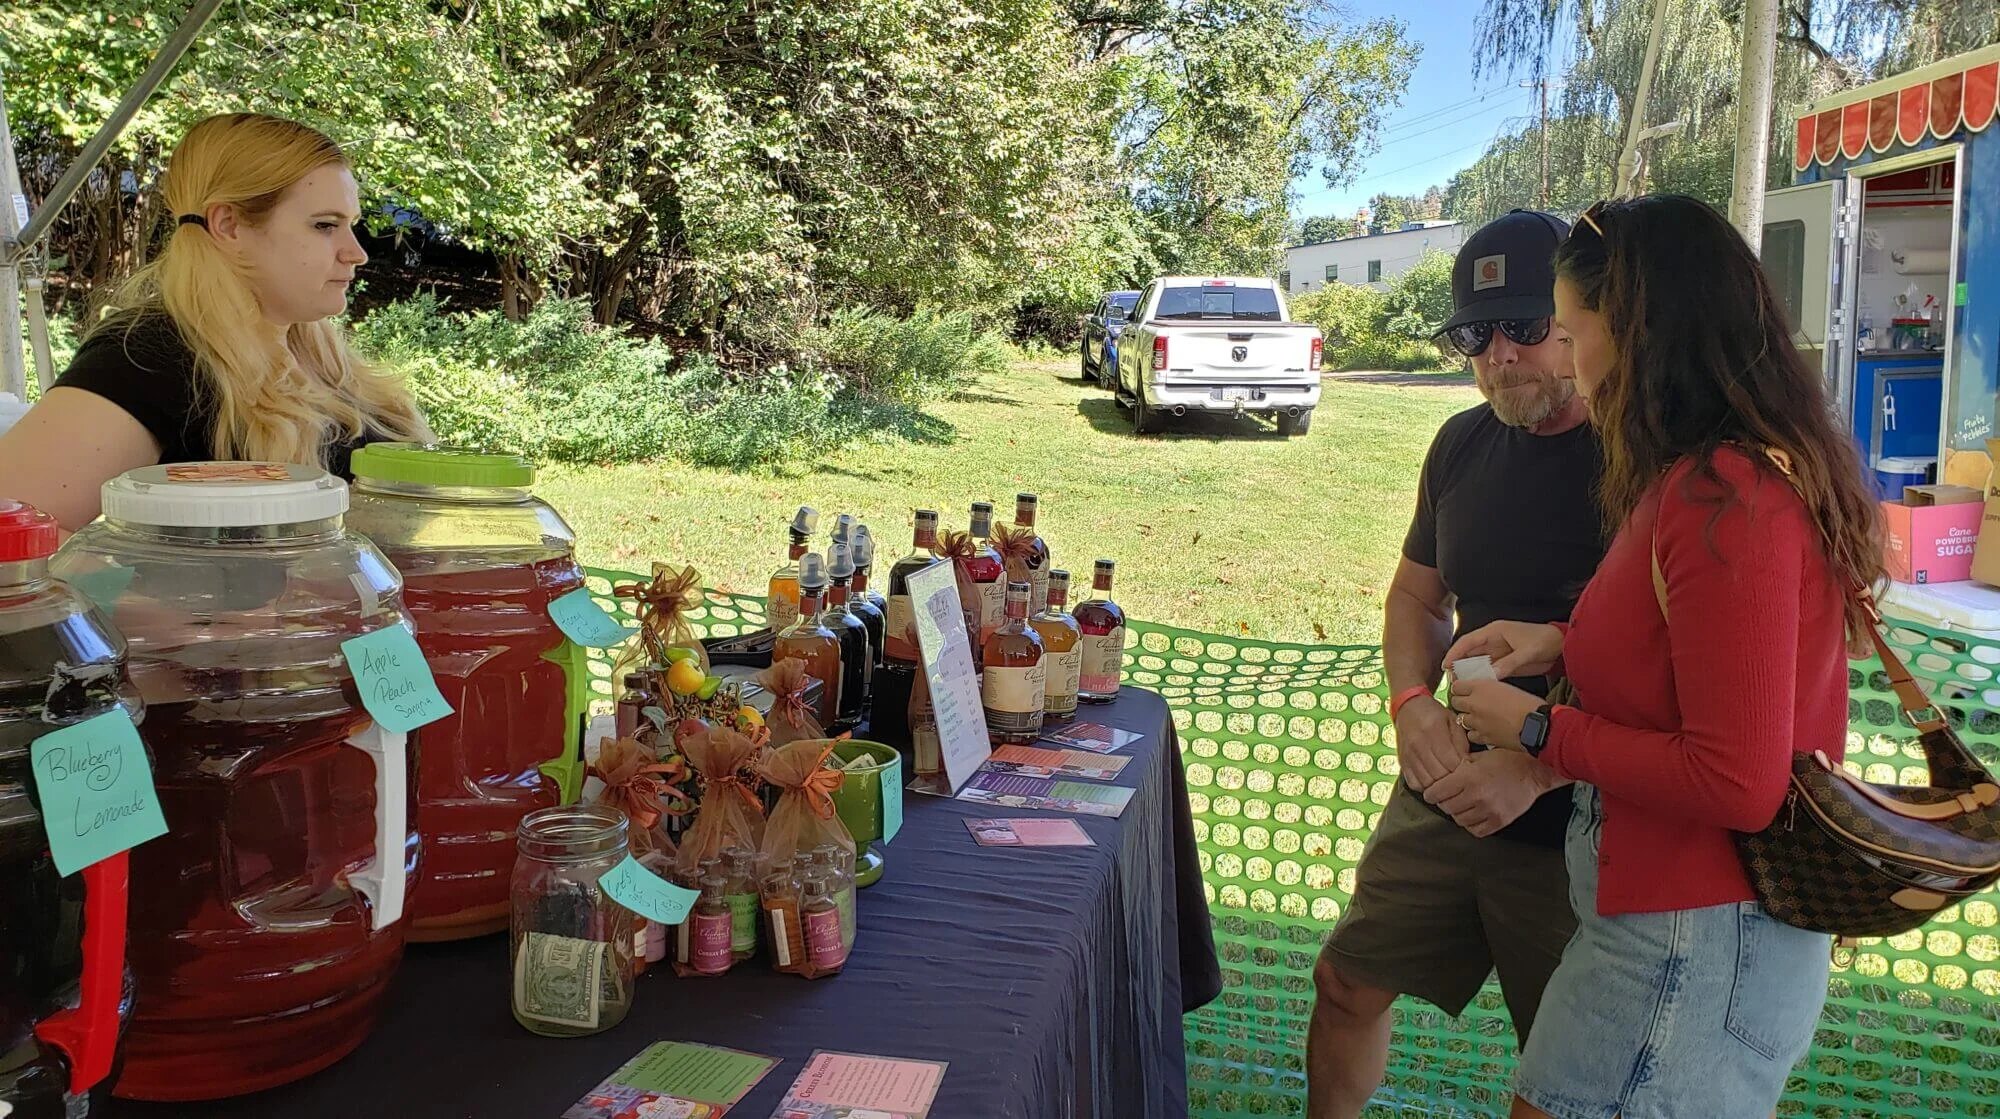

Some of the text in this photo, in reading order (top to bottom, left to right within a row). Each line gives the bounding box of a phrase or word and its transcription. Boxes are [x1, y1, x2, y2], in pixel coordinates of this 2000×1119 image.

[1949, 527, 1972, 537] Cane
[362, 647, 401, 678] Apple
[373, 677, 416, 704] Peach
[37, 741, 123, 792] Blueberry
[74, 789, 145, 837] Lemonade
